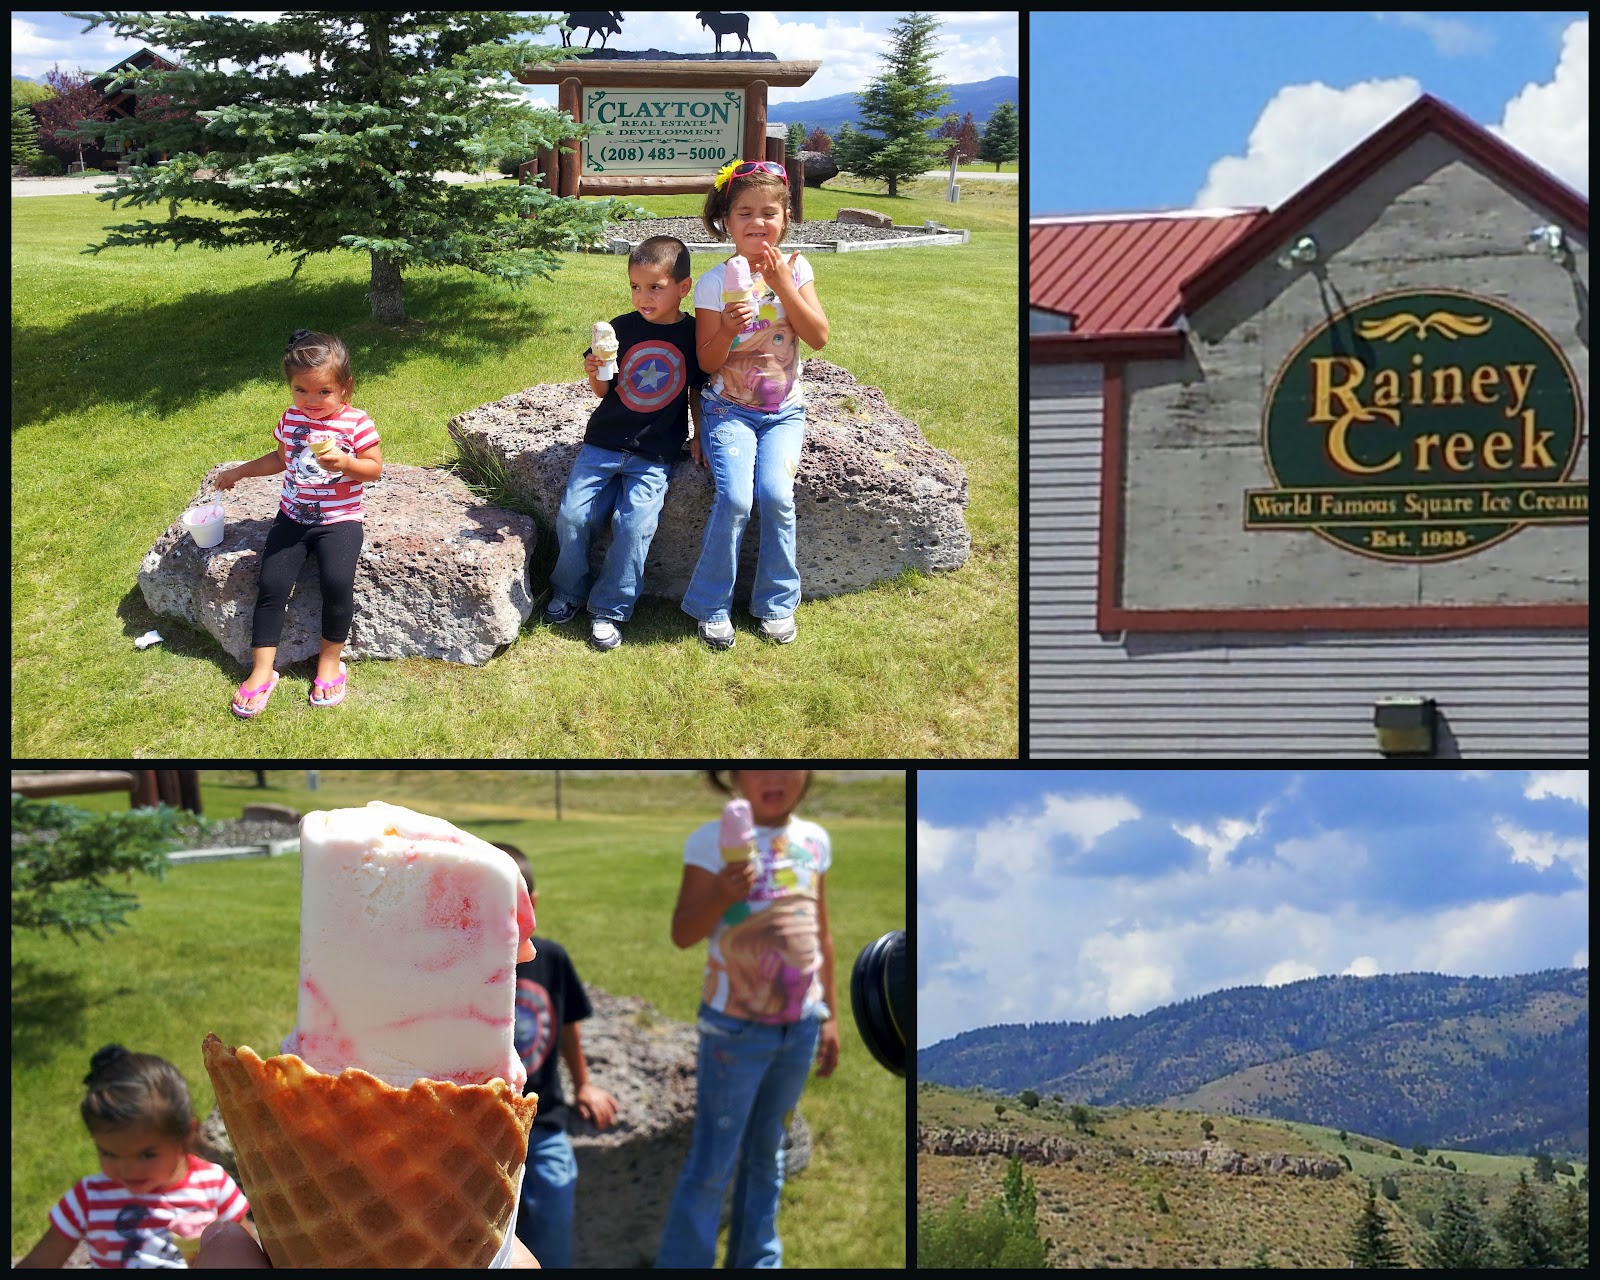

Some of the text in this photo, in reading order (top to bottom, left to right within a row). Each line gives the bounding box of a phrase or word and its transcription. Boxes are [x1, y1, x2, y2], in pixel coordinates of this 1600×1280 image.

[597, 101, 731, 124] CLAYTON
[600, 147, 726, 162] (208) 483-5000
[1308, 354, 1536, 422] Rainey
[1327, 407, 1556, 474] Creek
[1253, 489, 1588, 518] World Famous Square Ice Cream
